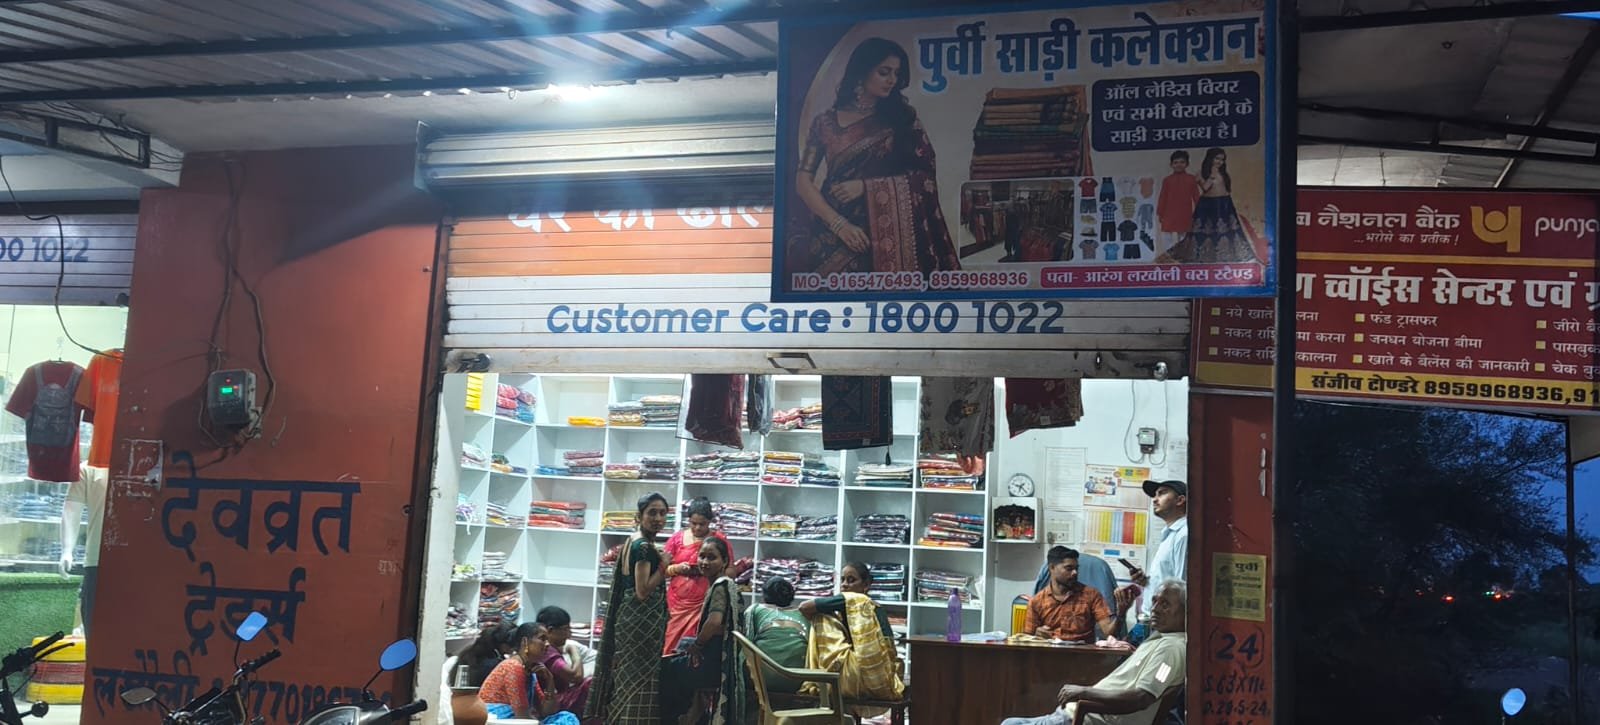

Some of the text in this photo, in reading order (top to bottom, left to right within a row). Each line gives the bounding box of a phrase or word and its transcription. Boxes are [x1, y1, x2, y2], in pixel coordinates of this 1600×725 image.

[918, 12, 1260, 93] पुर्वी साड़ी कलेक्शन
[1104, 78, 1239, 100] ऑल लेडिस वियर
[1102, 98, 1252, 122] एवं सभी वैरायटी के
[1110, 126, 1146, 146] साड़ी
[1152, 126, 1211, 142] उपलब्ध
[1318, 204, 1406, 229] नैशनल
[1416, 205, 1460, 230] बैंक
[1399, 233, 1415, 243] का
[829, 272, 927, 291] 9165476493,
[931, 271, 1028, 288] 8959968936
[1084, 268, 1122, 283] आरंग
[1185, 269, 1208, 281] बस
[1432, 268, 1516, 307] सेन्टर
[1523, 271, 1578, 308] एवं
[547, 302, 729, 333] Customer
[741, 302, 831, 333] Care
[865, 301, 959, 333] 1800
[971, 300, 1064, 333] 1022
[1226, 304, 1243, 318] नये
[1248, 306, 1274, 319] खाते
[1370, 311, 1392, 324] फंड
[1225, 326, 1252, 338] नकद
[1316, 332, 1345, 344] करना
[1553, 319, 1580, 332] जीरो
[1412, 333, 1449, 347] योजना
[1455, 335, 1482, 349] बीमा
[1223, 347, 1251, 359] नकद
[1368, 352, 1394, 366] खाते
[1400, 352, 1412, 366] के
[1456, 356, 1472, 370] की
[1478, 359, 1530, 373] जानकारी
[1552, 360, 1577, 375] चेक
[1312, 371, 1363, 390] संजीव
[161, 451, 361, 562] देवव्रत
